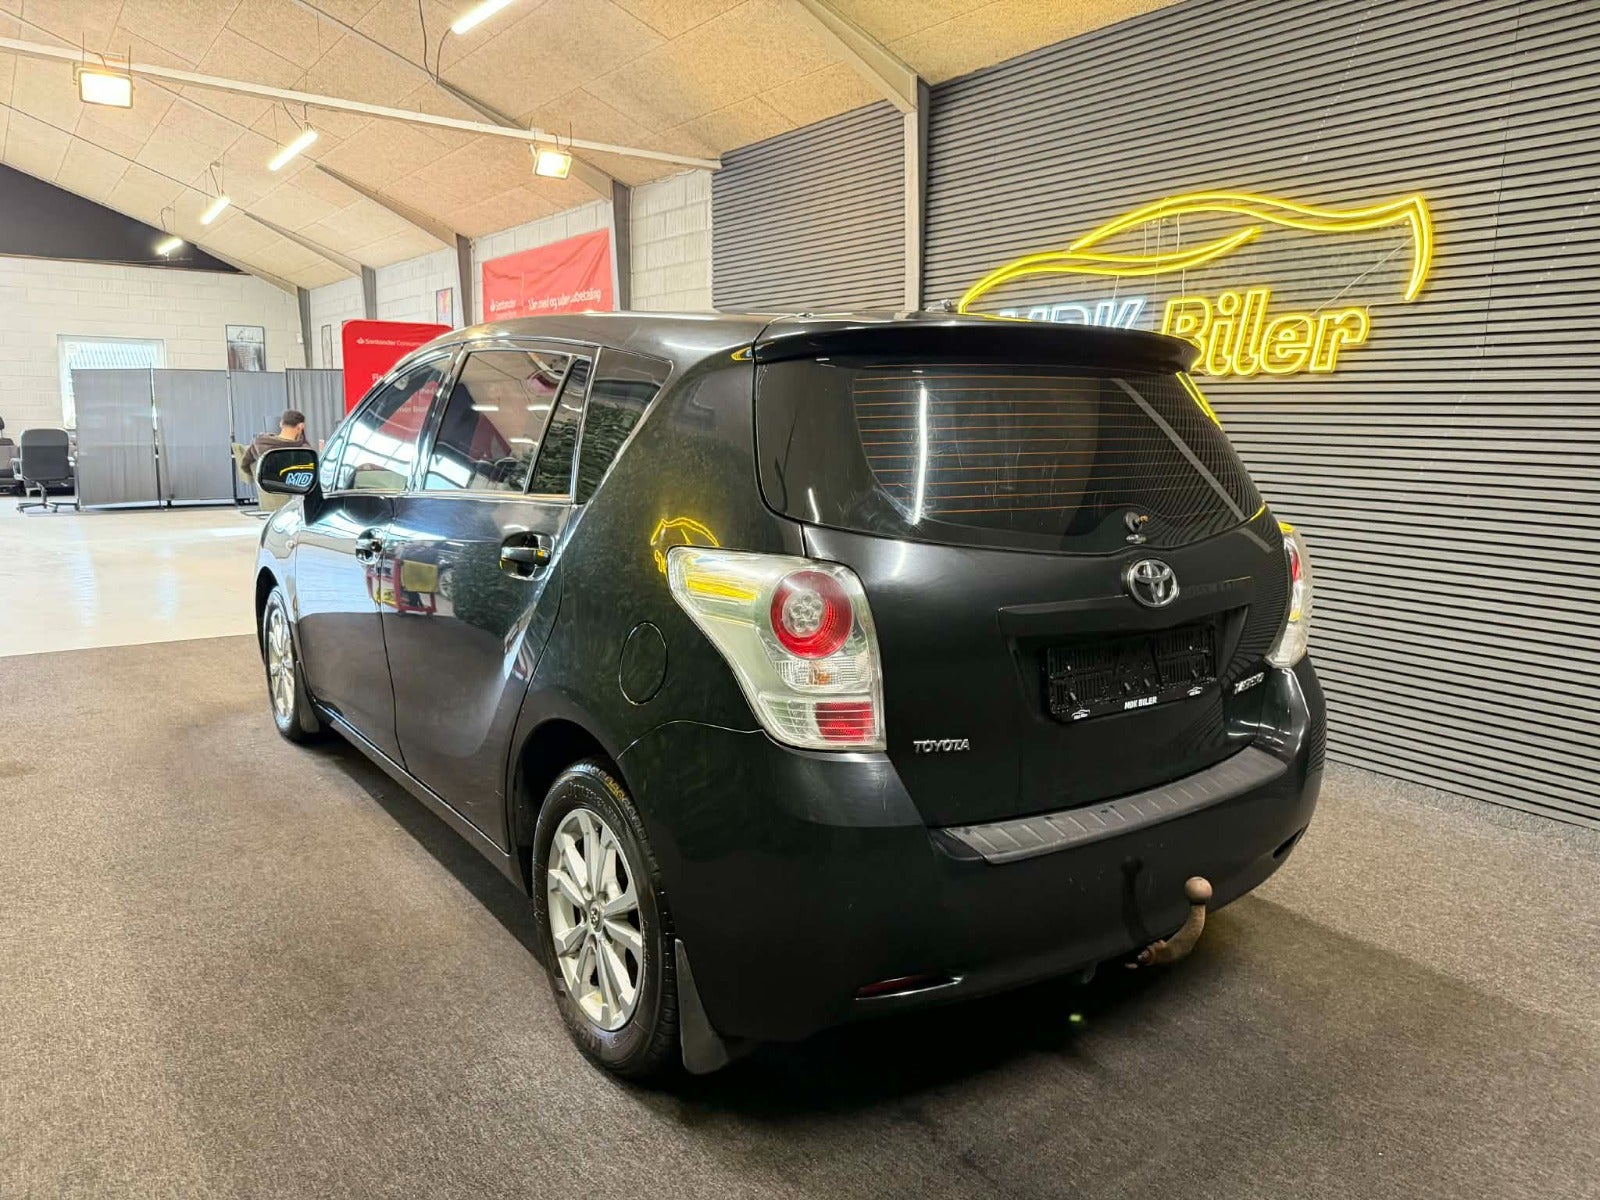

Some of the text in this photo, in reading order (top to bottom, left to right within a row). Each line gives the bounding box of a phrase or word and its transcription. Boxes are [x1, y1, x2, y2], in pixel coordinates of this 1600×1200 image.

[1161, 288, 1370, 376] Biler
[365, 338, 396, 346] Santander
[913, 738, 970, 754] TOYOTA
